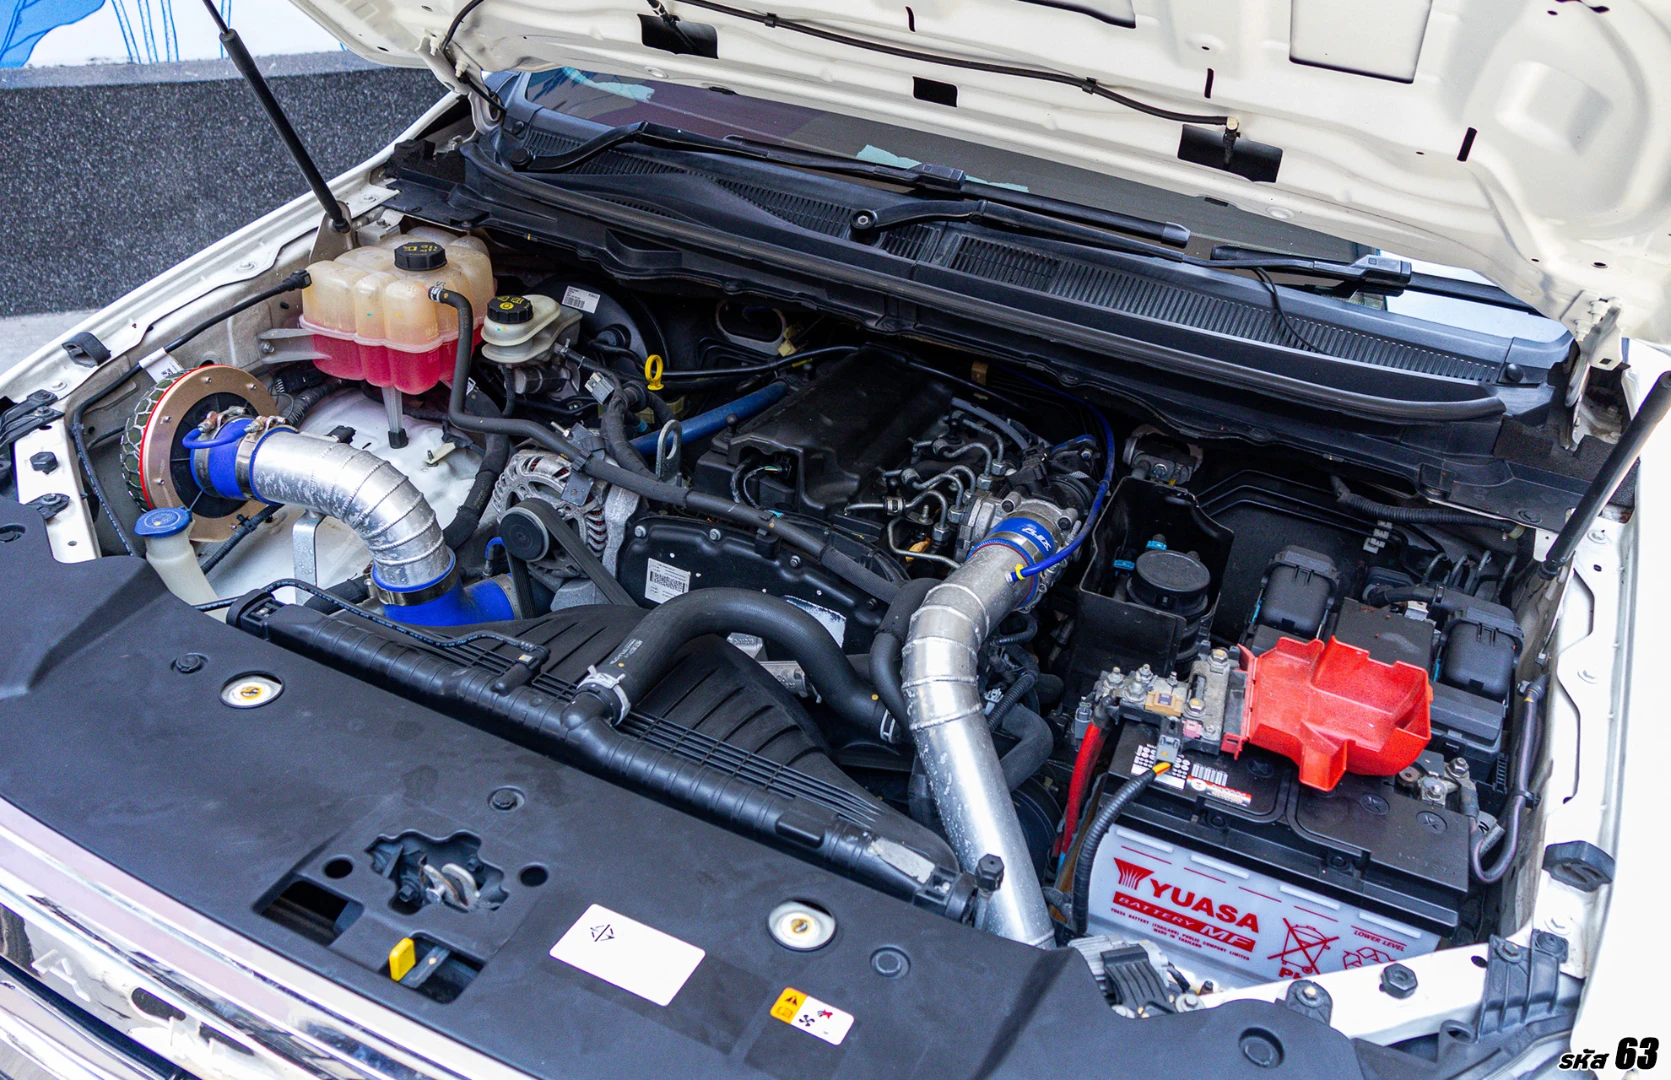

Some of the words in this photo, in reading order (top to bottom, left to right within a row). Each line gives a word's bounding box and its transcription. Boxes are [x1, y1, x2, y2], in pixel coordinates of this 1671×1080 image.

[1118, 897, 1195, 926] BATTERY
[1200, 925, 1252, 946] MF
[1150, 878, 1259, 933] YUASA
[1128, 914, 1150, 925] BATTERY
[1152, 922, 1180, 937] (THAILAND)
[1182, 933, 1200, 943] PUBLIC
[1202, 941, 1227, 953] COMPANY
[1229, 950, 1250, 961] LIMITED
[1153, 928, 1167, 937] MADE
[1178, 936, 1202, 949] THAILAND
[1354, 930, 1381, 944] LOWER
[1382, 940, 1405, 952] LEVEL
